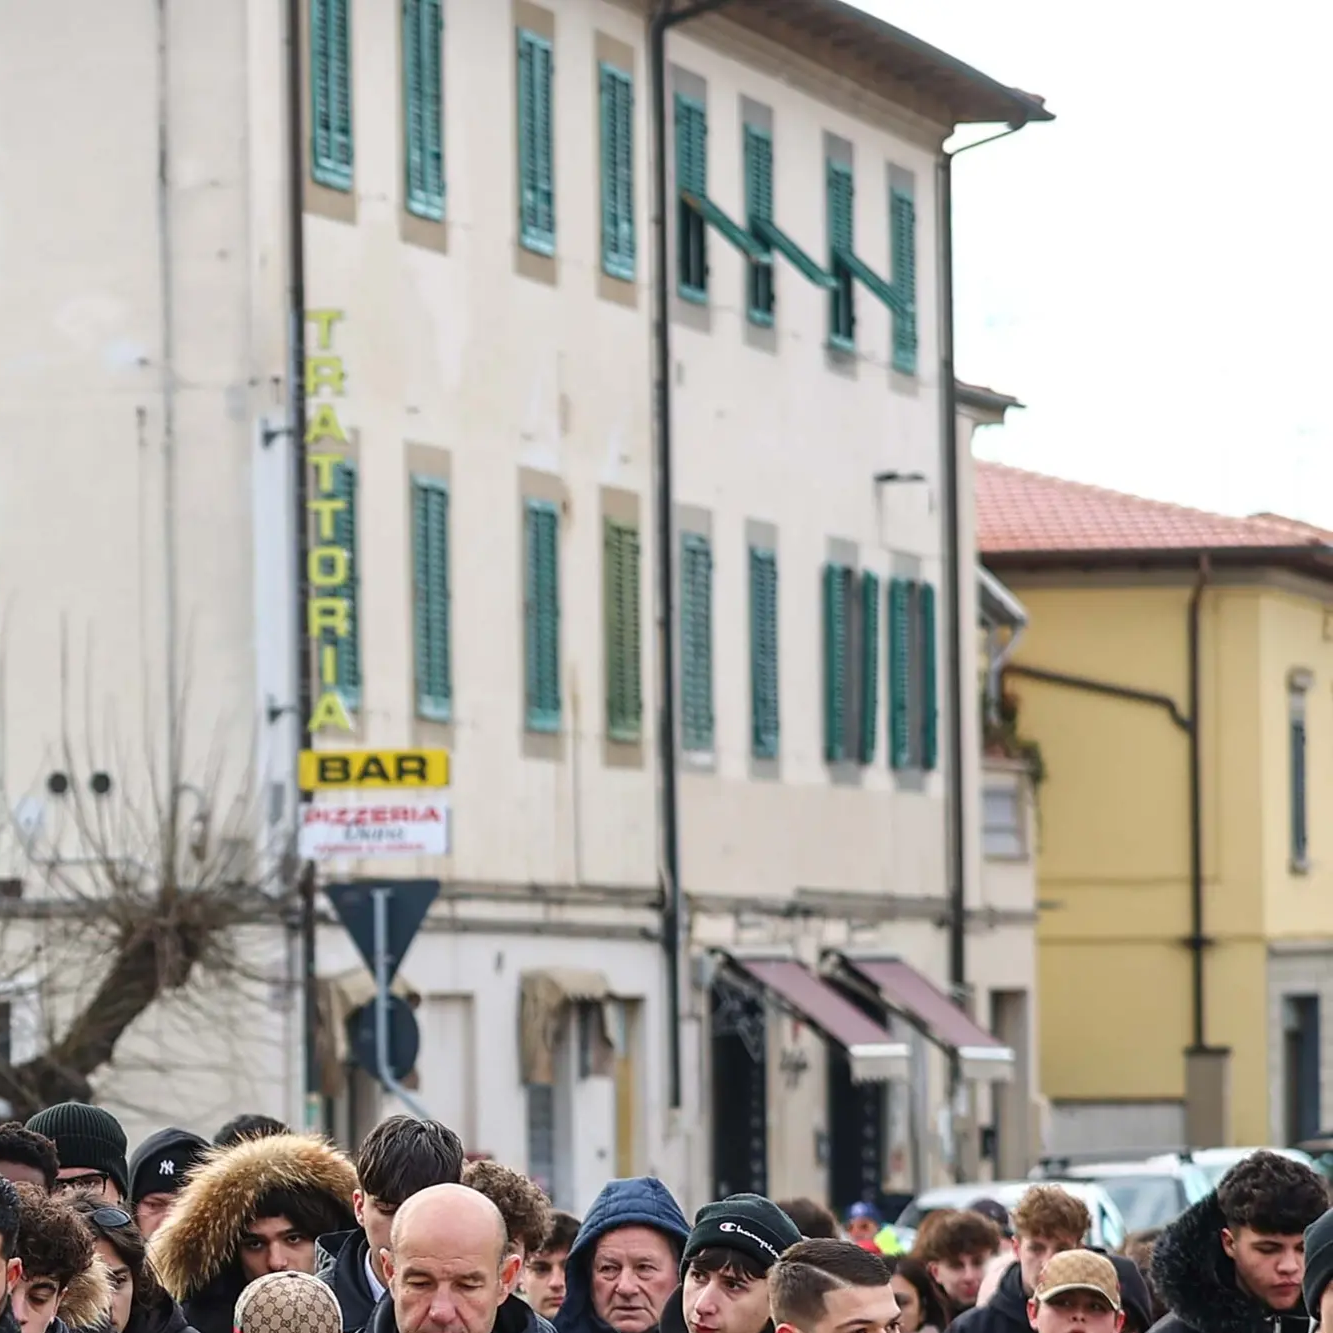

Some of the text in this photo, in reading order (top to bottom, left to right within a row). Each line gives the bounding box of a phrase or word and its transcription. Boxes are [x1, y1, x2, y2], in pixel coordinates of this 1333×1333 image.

[305, 309, 353, 733] TRATTORIA
[317, 755, 428, 784] BAR
[304, 804, 440, 825] PIZZERIA
[159, 1159, 174, 1175] NY
